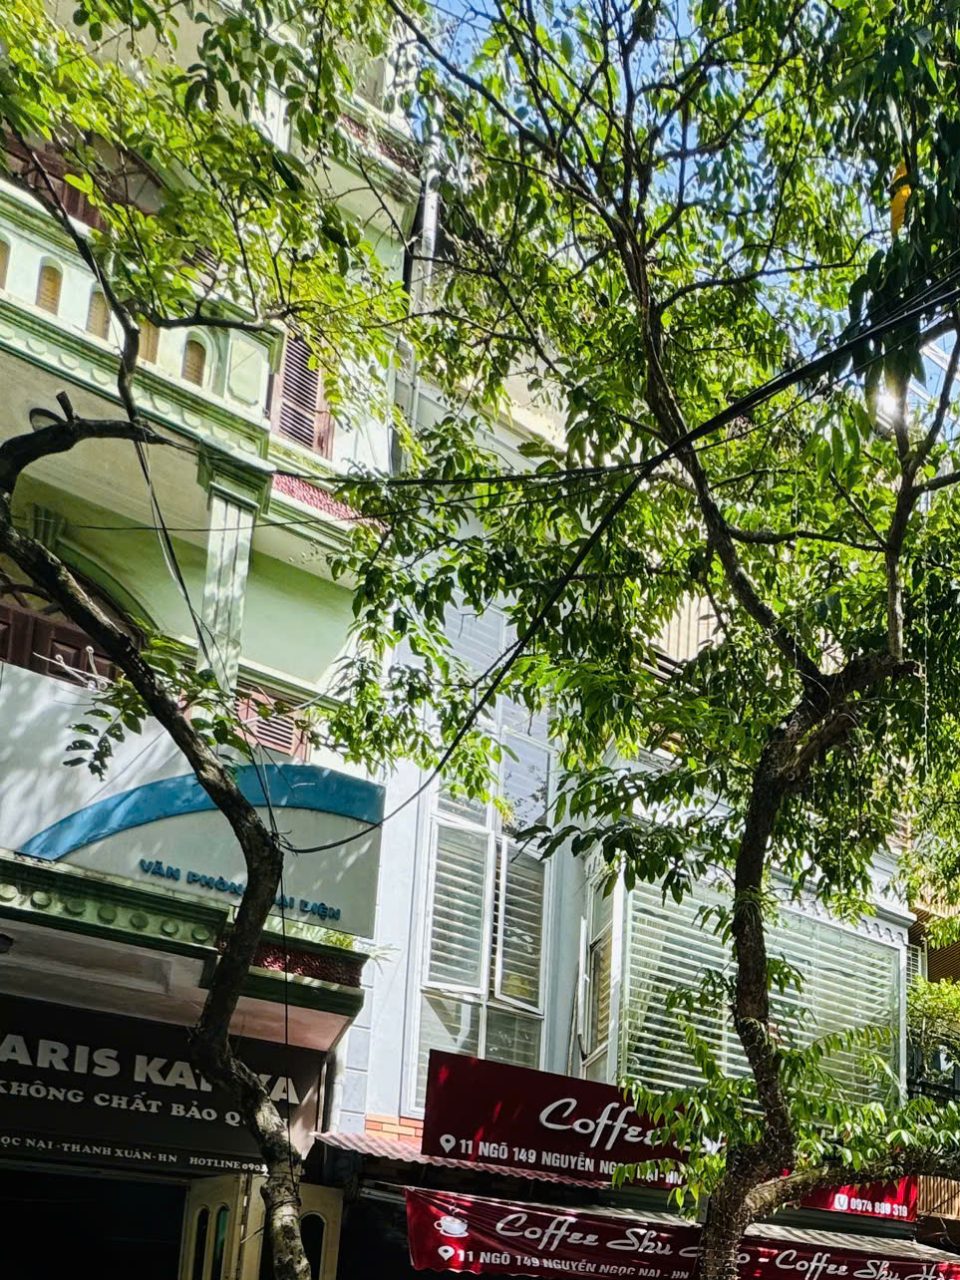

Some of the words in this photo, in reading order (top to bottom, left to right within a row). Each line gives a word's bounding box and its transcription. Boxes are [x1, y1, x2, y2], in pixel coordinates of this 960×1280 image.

[186, 870, 245, 896] PHÒN
[94, 1090, 163, 1114] CHẤT
[170, 1101, 218, 1121] BẢO
[539, 1098, 663, 1151] Coffee
[189, 1156, 241, 1170] HOTLINE
[459, 1138, 473, 1154] 11
[478, 1141, 509, 1160] NGÕ
[513, 1146, 537, 1163] 149
[541, 1151, 595, 1173] NGUYỄN
[850, 1197, 873, 1213] 0974
[495, 1212, 599, 1251] Coffee
[606, 1227, 673, 1256] Shu
[457, 1249, 474, 1263] 11
[515, 1254, 540, 1267] 149
[599, 1264, 636, 1277] NGỌC
[775, 1249, 848, 1280] Coffee
